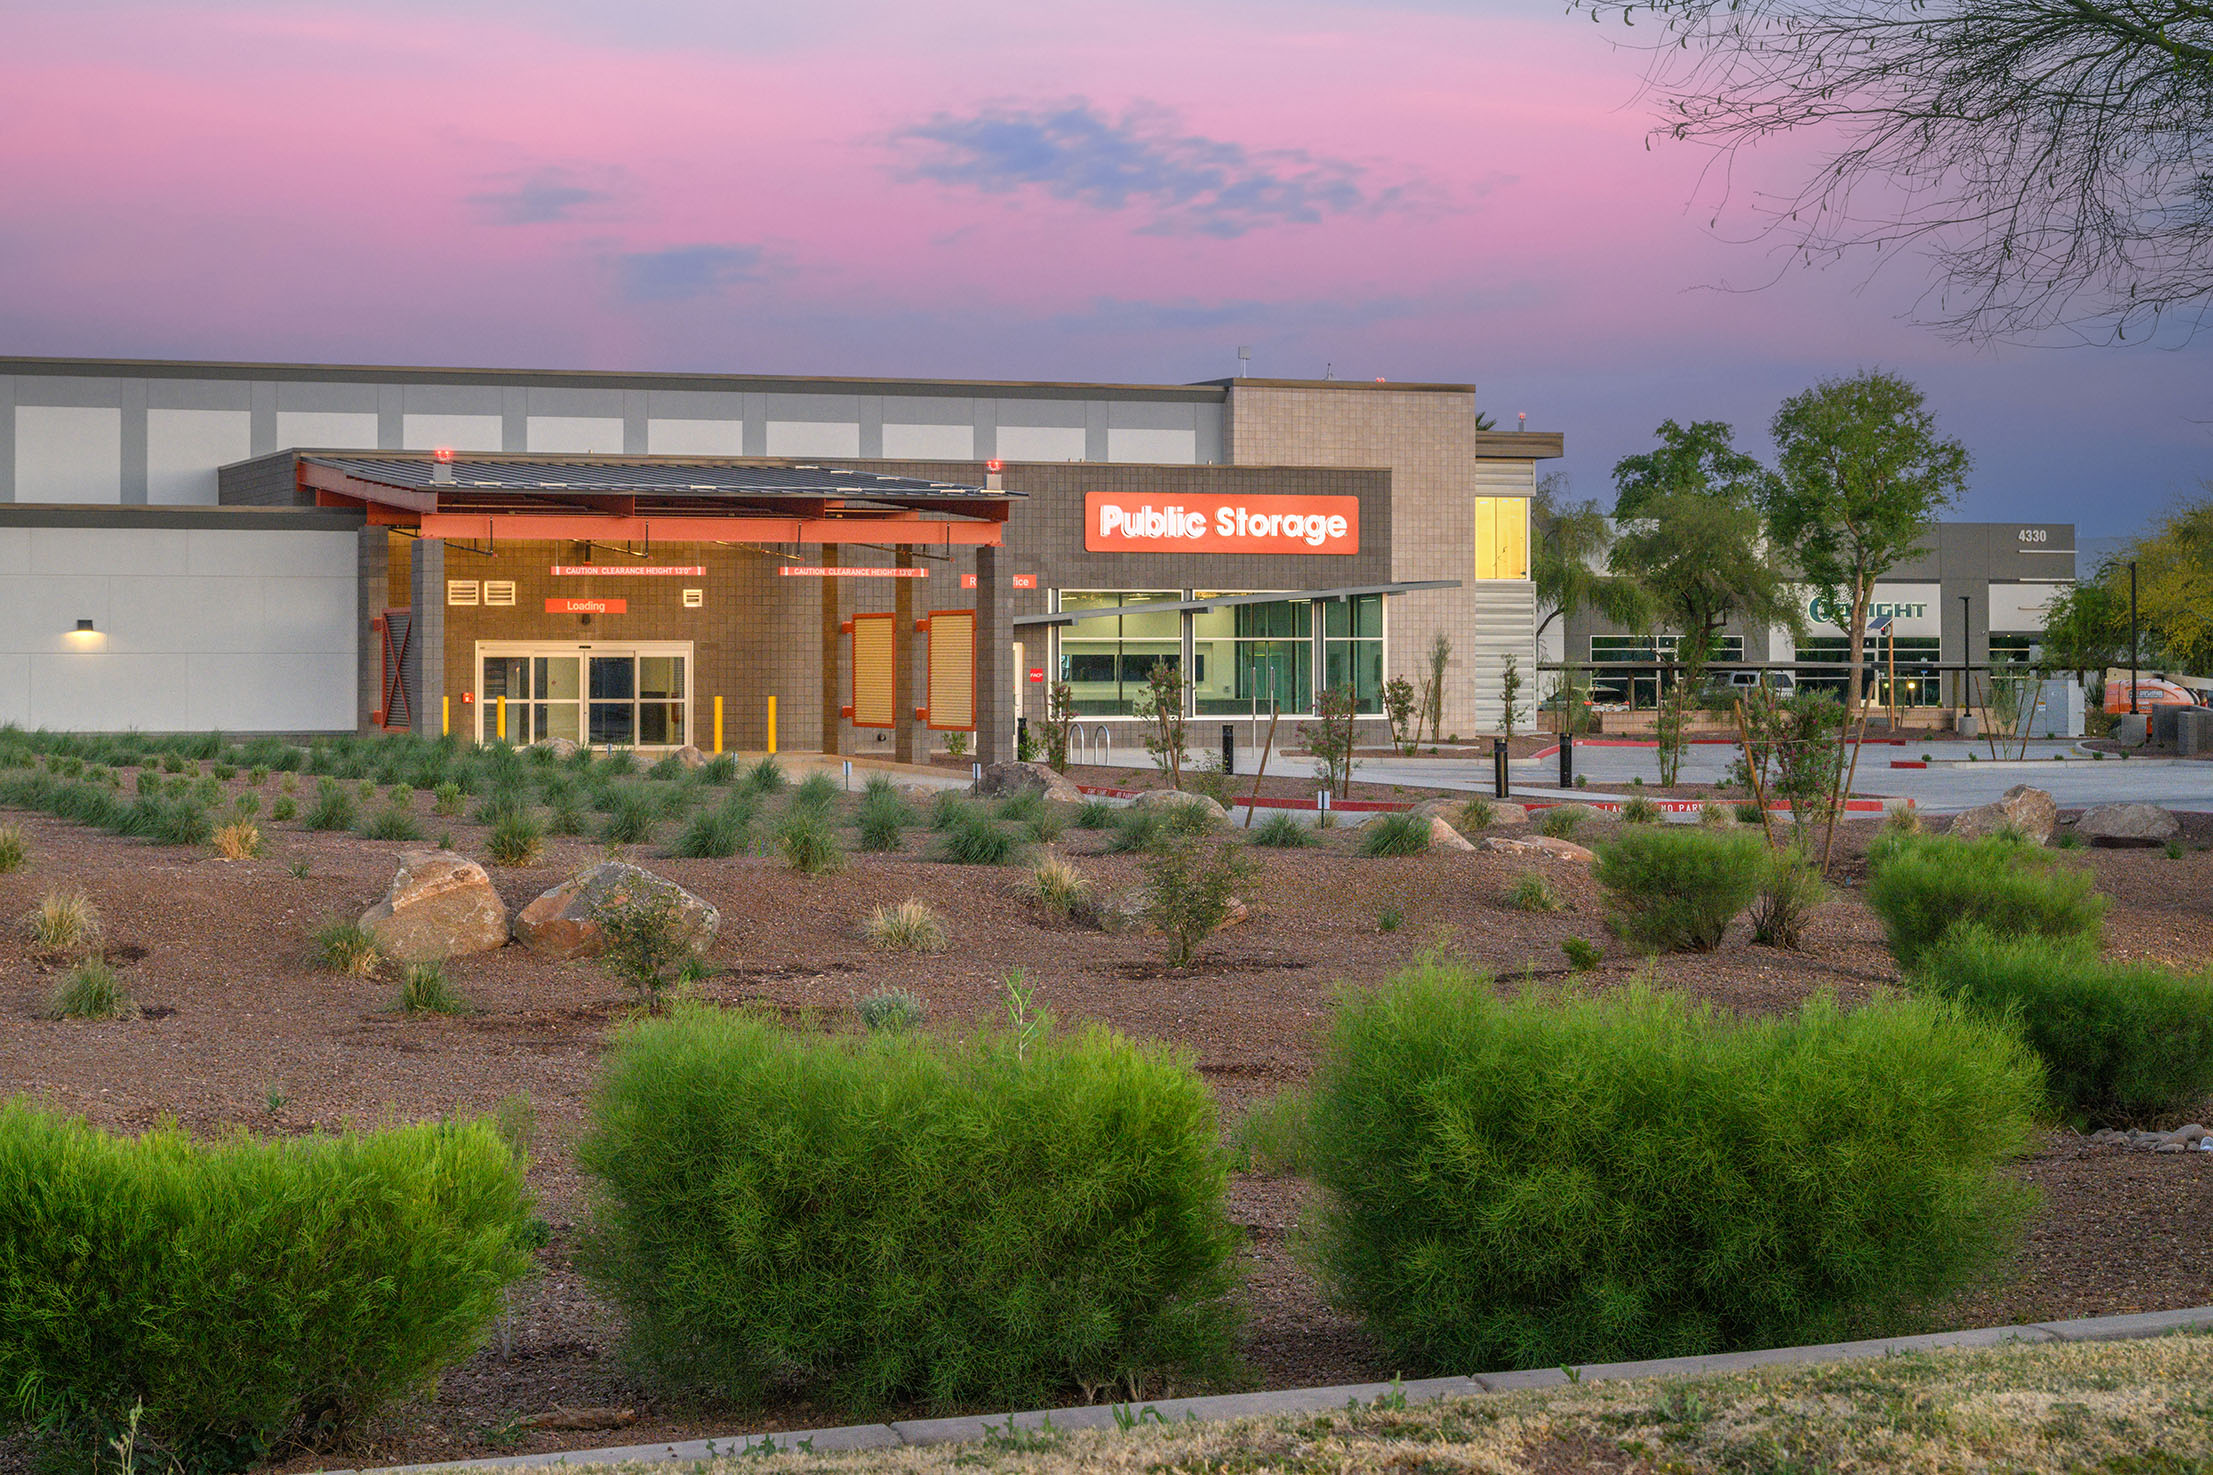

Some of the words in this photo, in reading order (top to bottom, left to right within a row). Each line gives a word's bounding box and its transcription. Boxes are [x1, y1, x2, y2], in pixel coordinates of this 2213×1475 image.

[1100, 505, 1207, 539] Public
[1214, 506, 1348, 546] Storage
[2018, 529, 2047, 542] 4330
[566, 567, 598, 575] CAUTION
[601, 567, 645, 575] CLEARANCE
[646, 567, 673, 575] HEIGHT
[794, 567, 825, 575] CAUTION
[828, 568, 870, 576] CLEARANCE
[871, 568, 897, 576] HEIGHT
[567, 601, 606, 613] Loading
